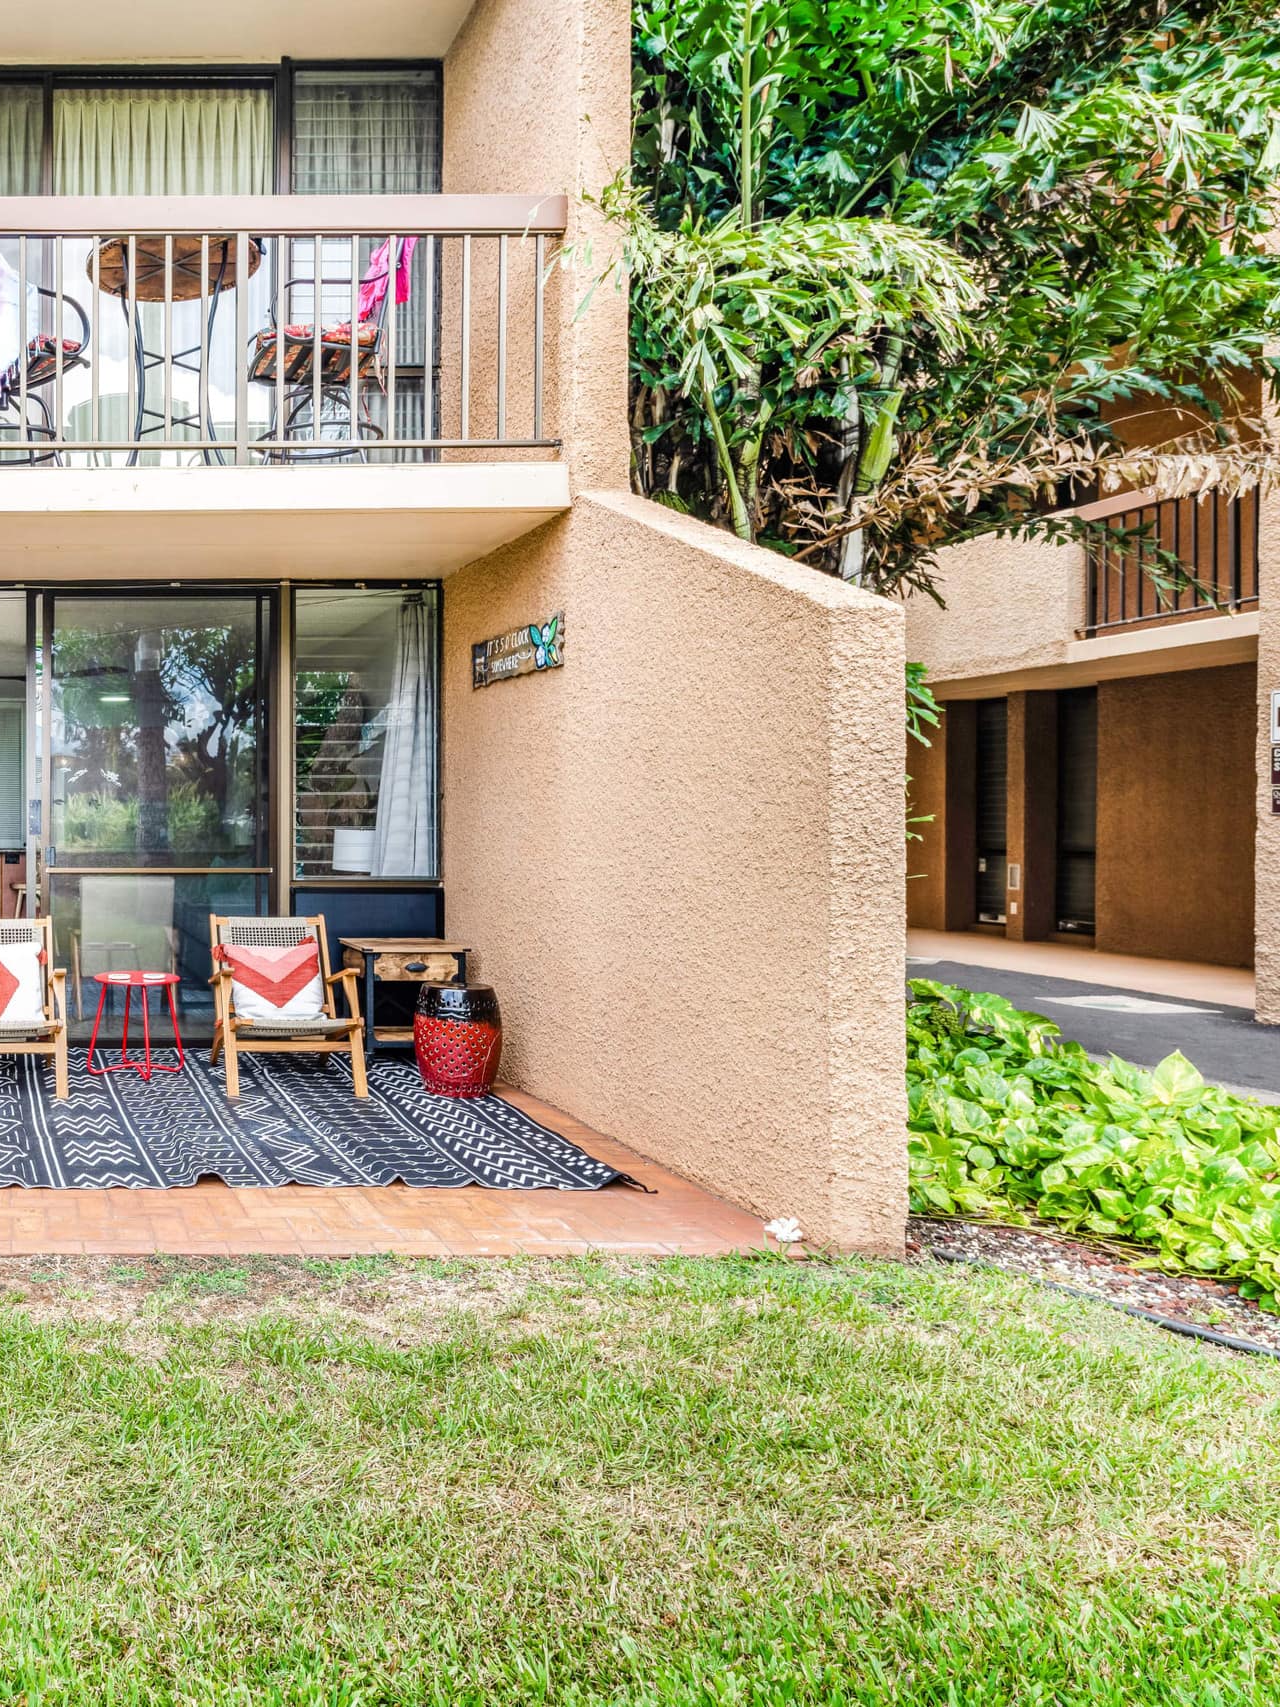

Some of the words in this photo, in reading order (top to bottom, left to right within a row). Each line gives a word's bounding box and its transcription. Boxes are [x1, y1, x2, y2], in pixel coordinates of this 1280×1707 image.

[487, 639, 499, 657] IT'S
[500, 637, 505, 653] 5
[505, 627, 529, 650] O'CLOCK
[491, 656, 518, 673] SOMEWHERE
